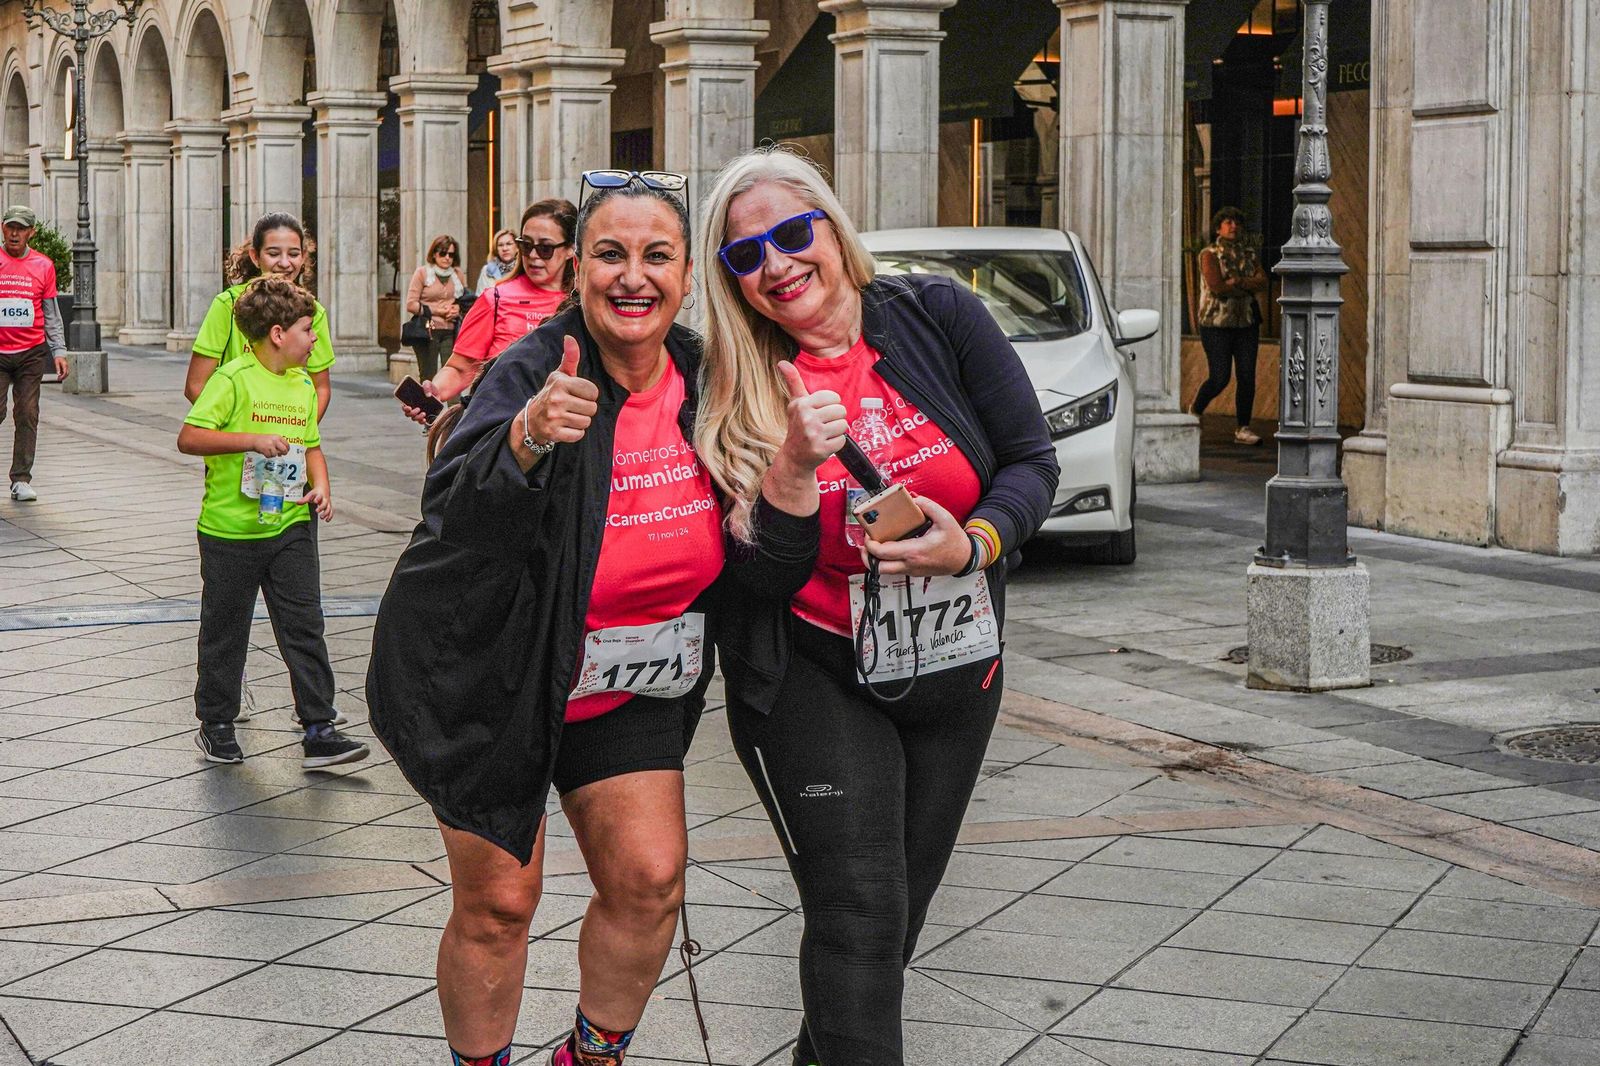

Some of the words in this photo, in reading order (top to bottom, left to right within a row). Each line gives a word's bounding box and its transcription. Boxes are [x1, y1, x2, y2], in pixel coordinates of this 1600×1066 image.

[2, 308, 29, 317] 1654
[253, 400, 297, 413] kilómetros
[252, 411, 307, 427] humanidad
[612, 444, 679, 467] ómetros
[610, 458, 700, 493] umanidad
[661, 531, 674, 539] nov
[679, 527, 689, 536] 24
[878, 595, 974, 641] 1772
[885, 642, 926, 660] Fuerza
[930, 629, 966, 650] Valencia
[602, 653, 683, 689] 1771
